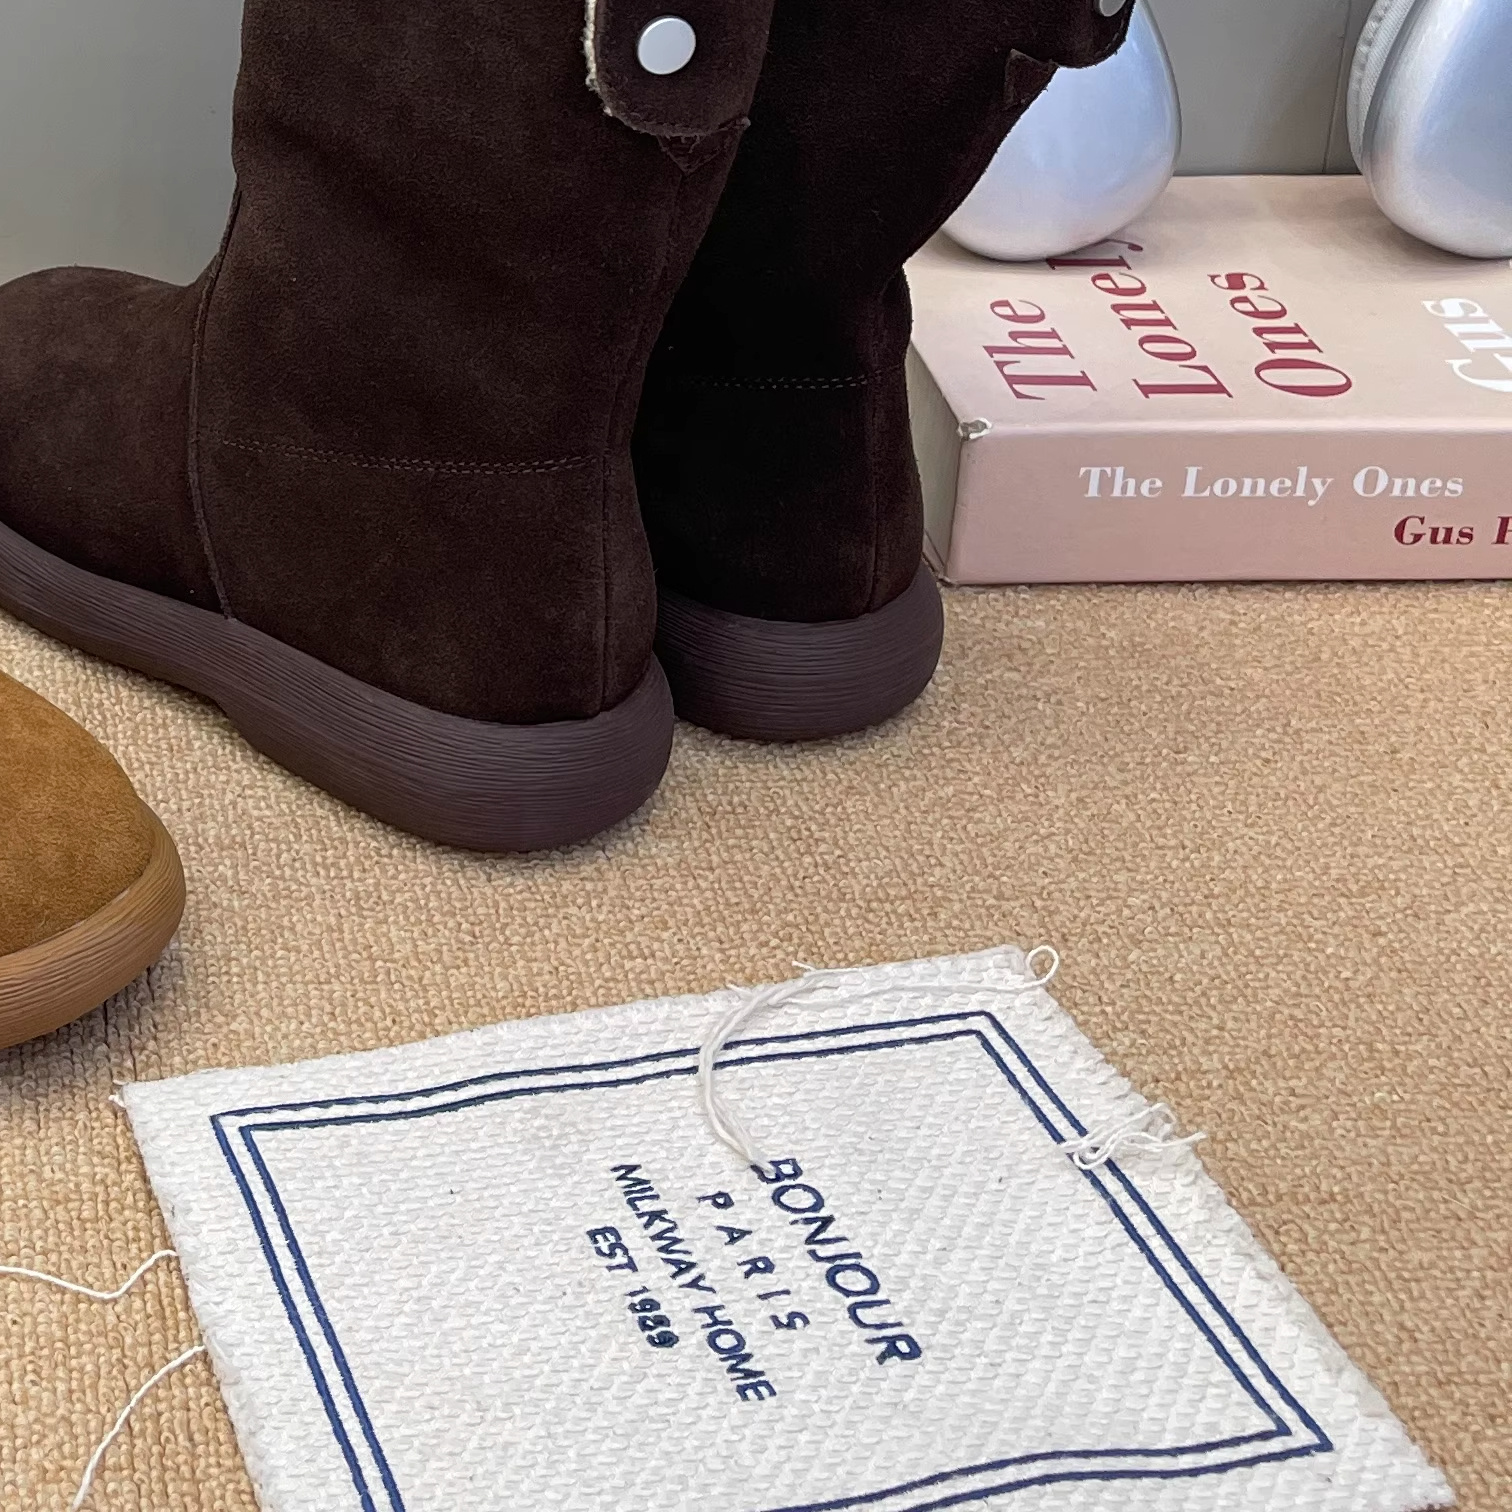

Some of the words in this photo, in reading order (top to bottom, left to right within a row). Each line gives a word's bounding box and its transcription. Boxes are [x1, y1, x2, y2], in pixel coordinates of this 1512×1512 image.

[982, 299, 1097, 400] The
[1207, 271, 1353, 397] Ones
[1079, 466, 1164, 499] The
[1181, 466, 1334, 506] Lonely
[1353, 466, 1465, 499] Ones
[1394, 515, 1474, 546] Gus
[586, 1226, 639, 1273] EST
[610, 1164, 717, 1294] MILKWAY
[692, 1304, 777, 1402] HOME
[751, 1158, 922, 1365] BONJOUR
